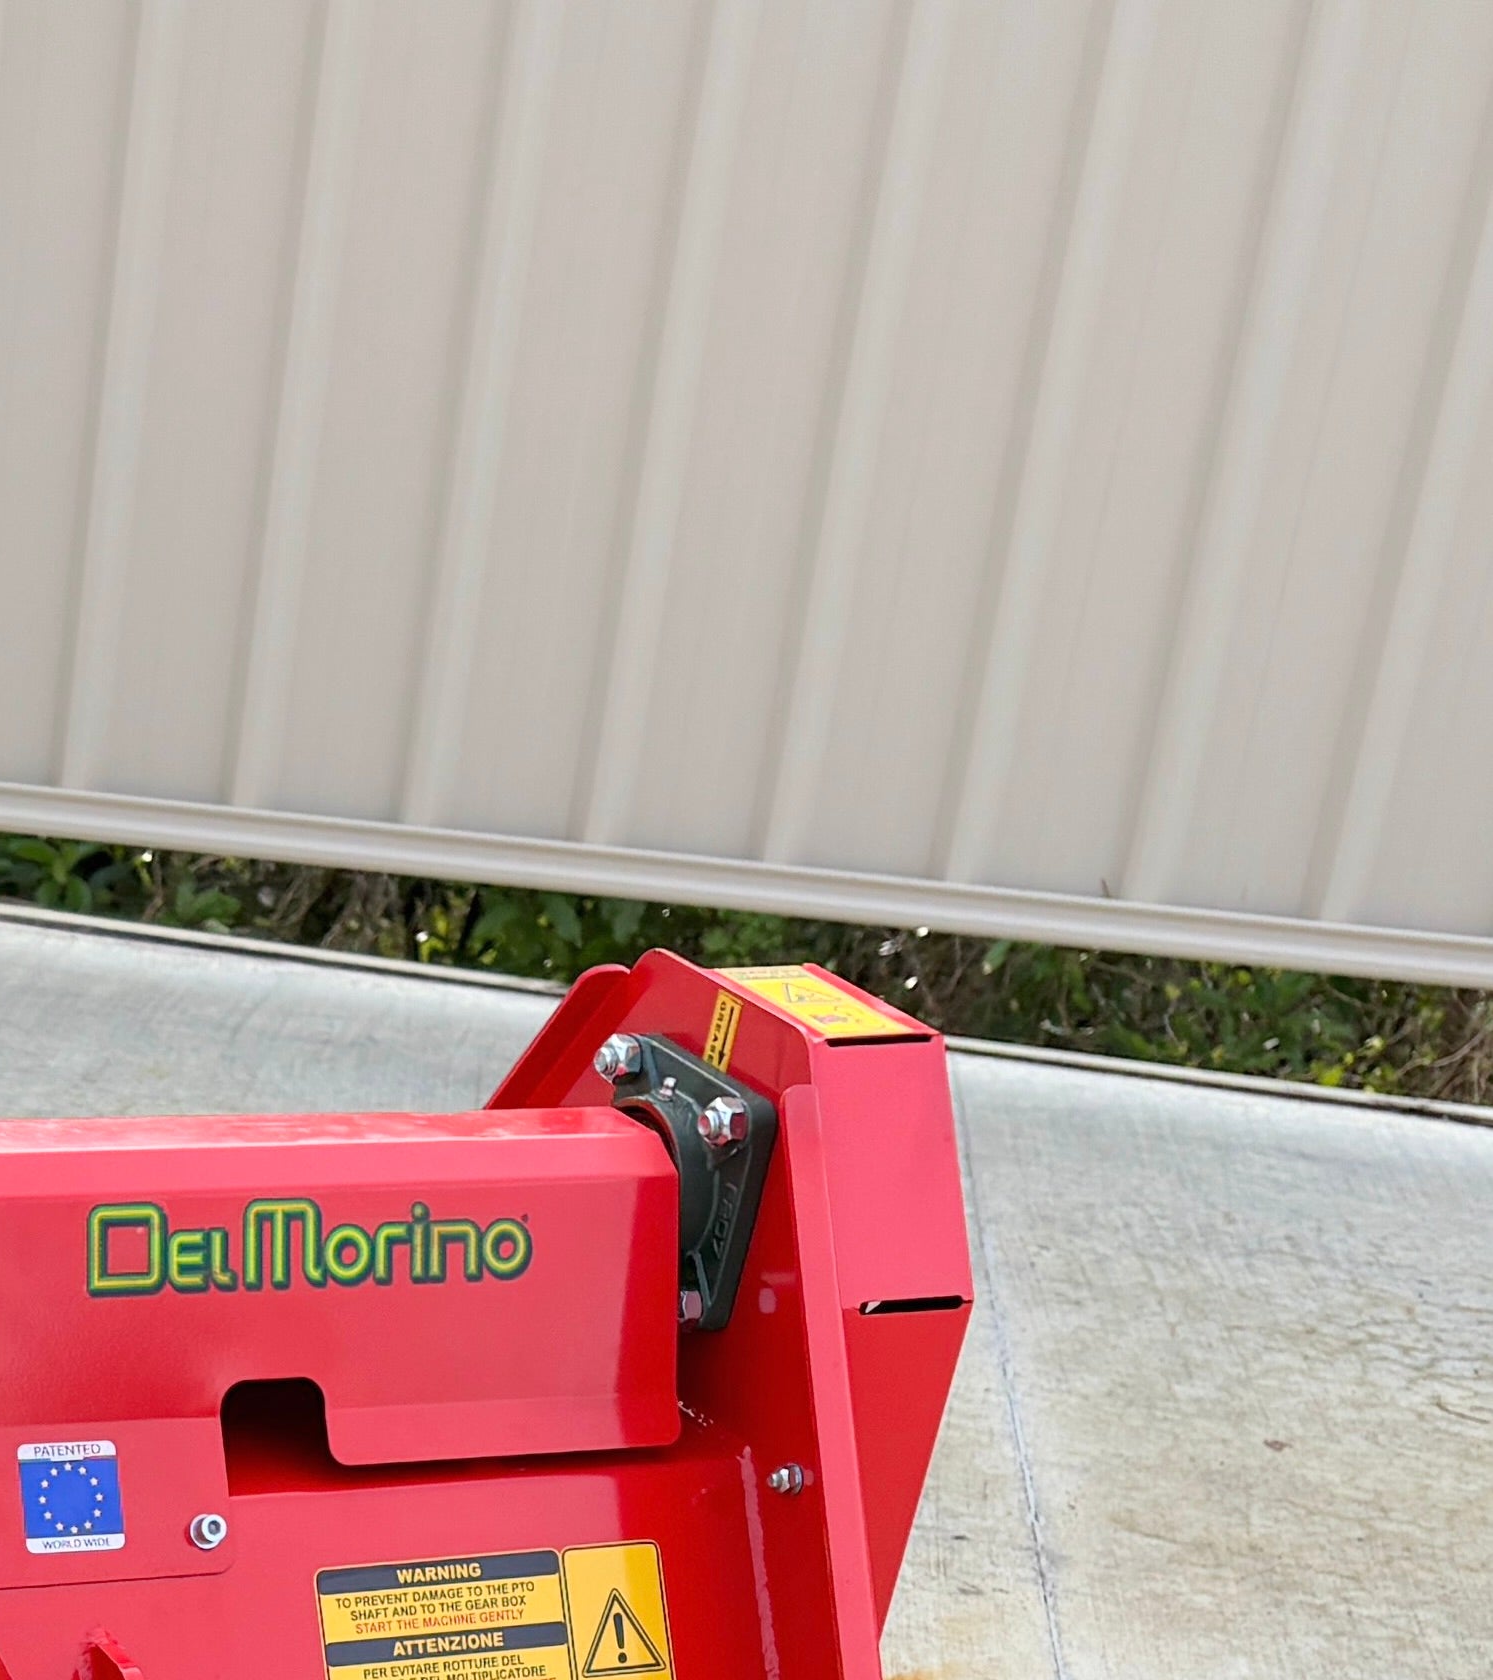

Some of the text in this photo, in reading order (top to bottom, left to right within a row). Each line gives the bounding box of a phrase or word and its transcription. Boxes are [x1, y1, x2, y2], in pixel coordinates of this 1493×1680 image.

[34, 1444, 101, 1457] PATENTED
[42, 1539, 81, 1549] WORLD
[397, 1563, 481, 1584] WARNING
[335, 1581, 535, 1609] TO PREVENT DAMAGE TO THE PTO
[350, 1595, 526, 1621] SHAFT AND TO THE GEAR BOX
[355, 1609, 524, 1634] START THE MACHINE GENTLY
[393, 1632, 504, 1657] ATTENZIONE
[363, 1655, 524, 1680] PER EVITARE ROTTURE DEL
